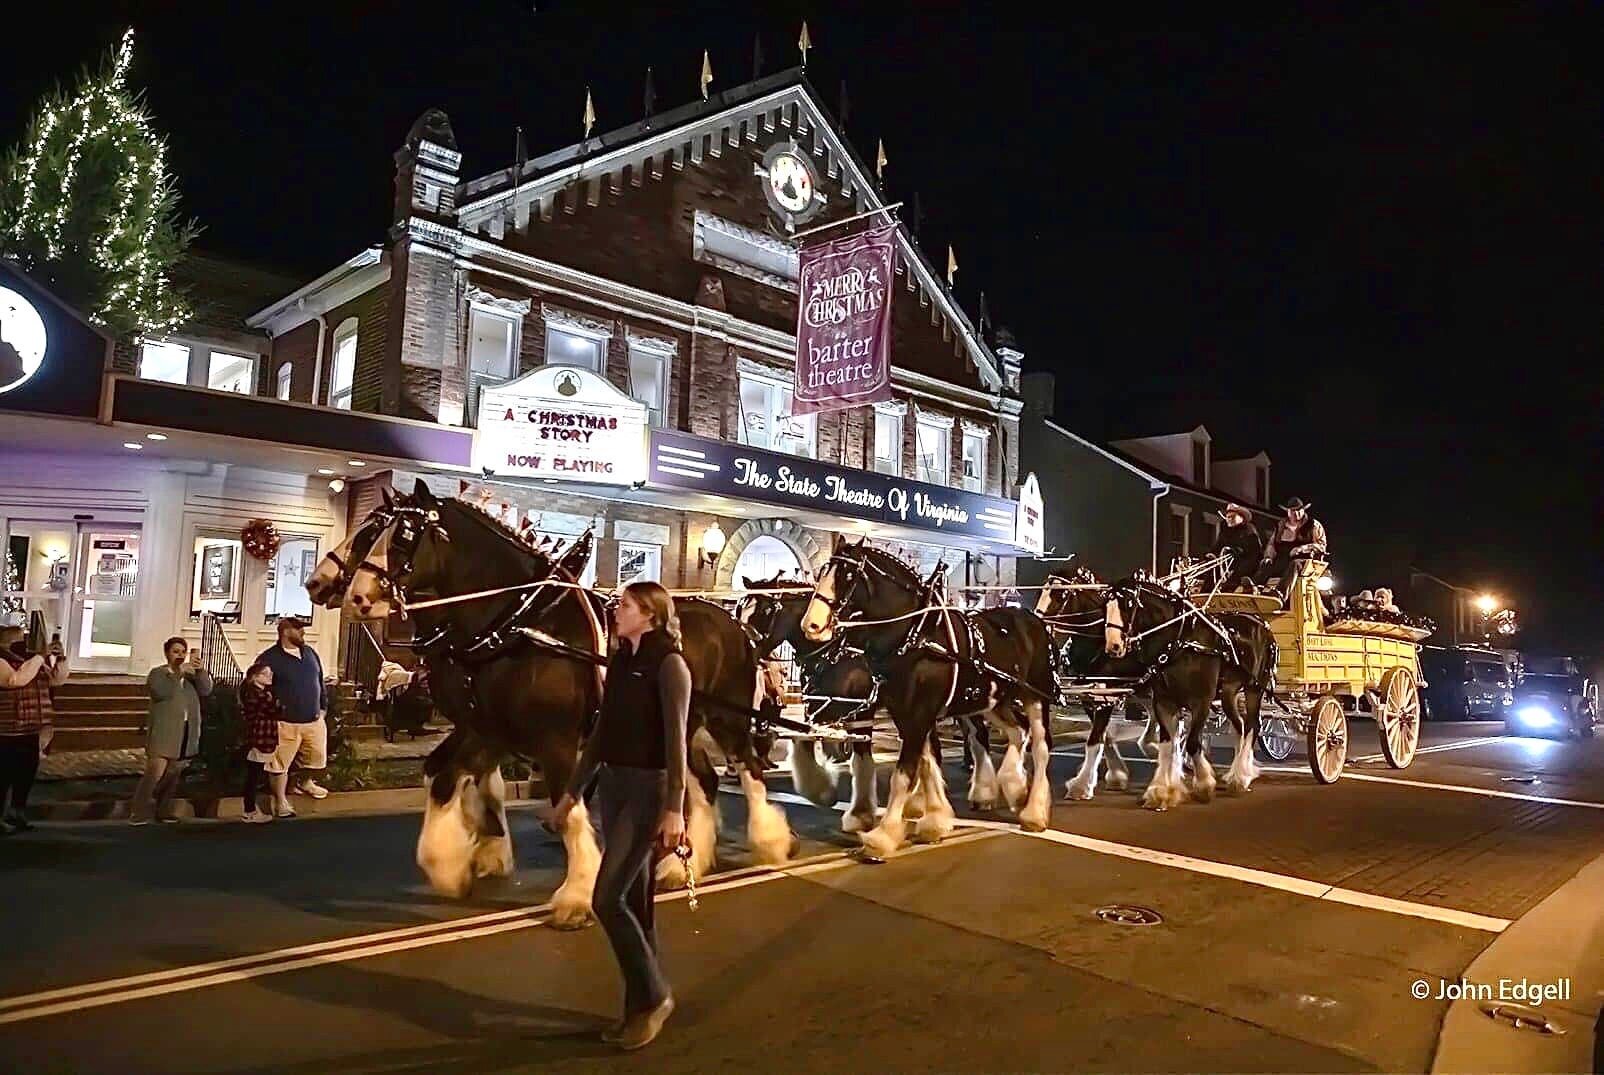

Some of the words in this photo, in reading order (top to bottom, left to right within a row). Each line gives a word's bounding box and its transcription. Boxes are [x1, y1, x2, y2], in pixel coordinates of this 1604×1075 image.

[822, 268, 868, 300] MERRY
[806, 289, 883, 327] CHRISTMAS
[808, 335, 872, 365] barter
[808, 362, 872, 387] theatre
[504, 408, 515, 421] A
[527, 410, 618, 430] CHRISTMAS
[540, 427, 594, 443] STORY
[507, 454, 541, 469] NOW
[553, 458, 613, 474] PLAYING
[733, 458, 772, 485] The
[775, 466, 820, 498] State
[825, 475, 884, 509] Theatre
[888, 487, 911, 520] Of
[914, 493, 968, 527] Virginia
